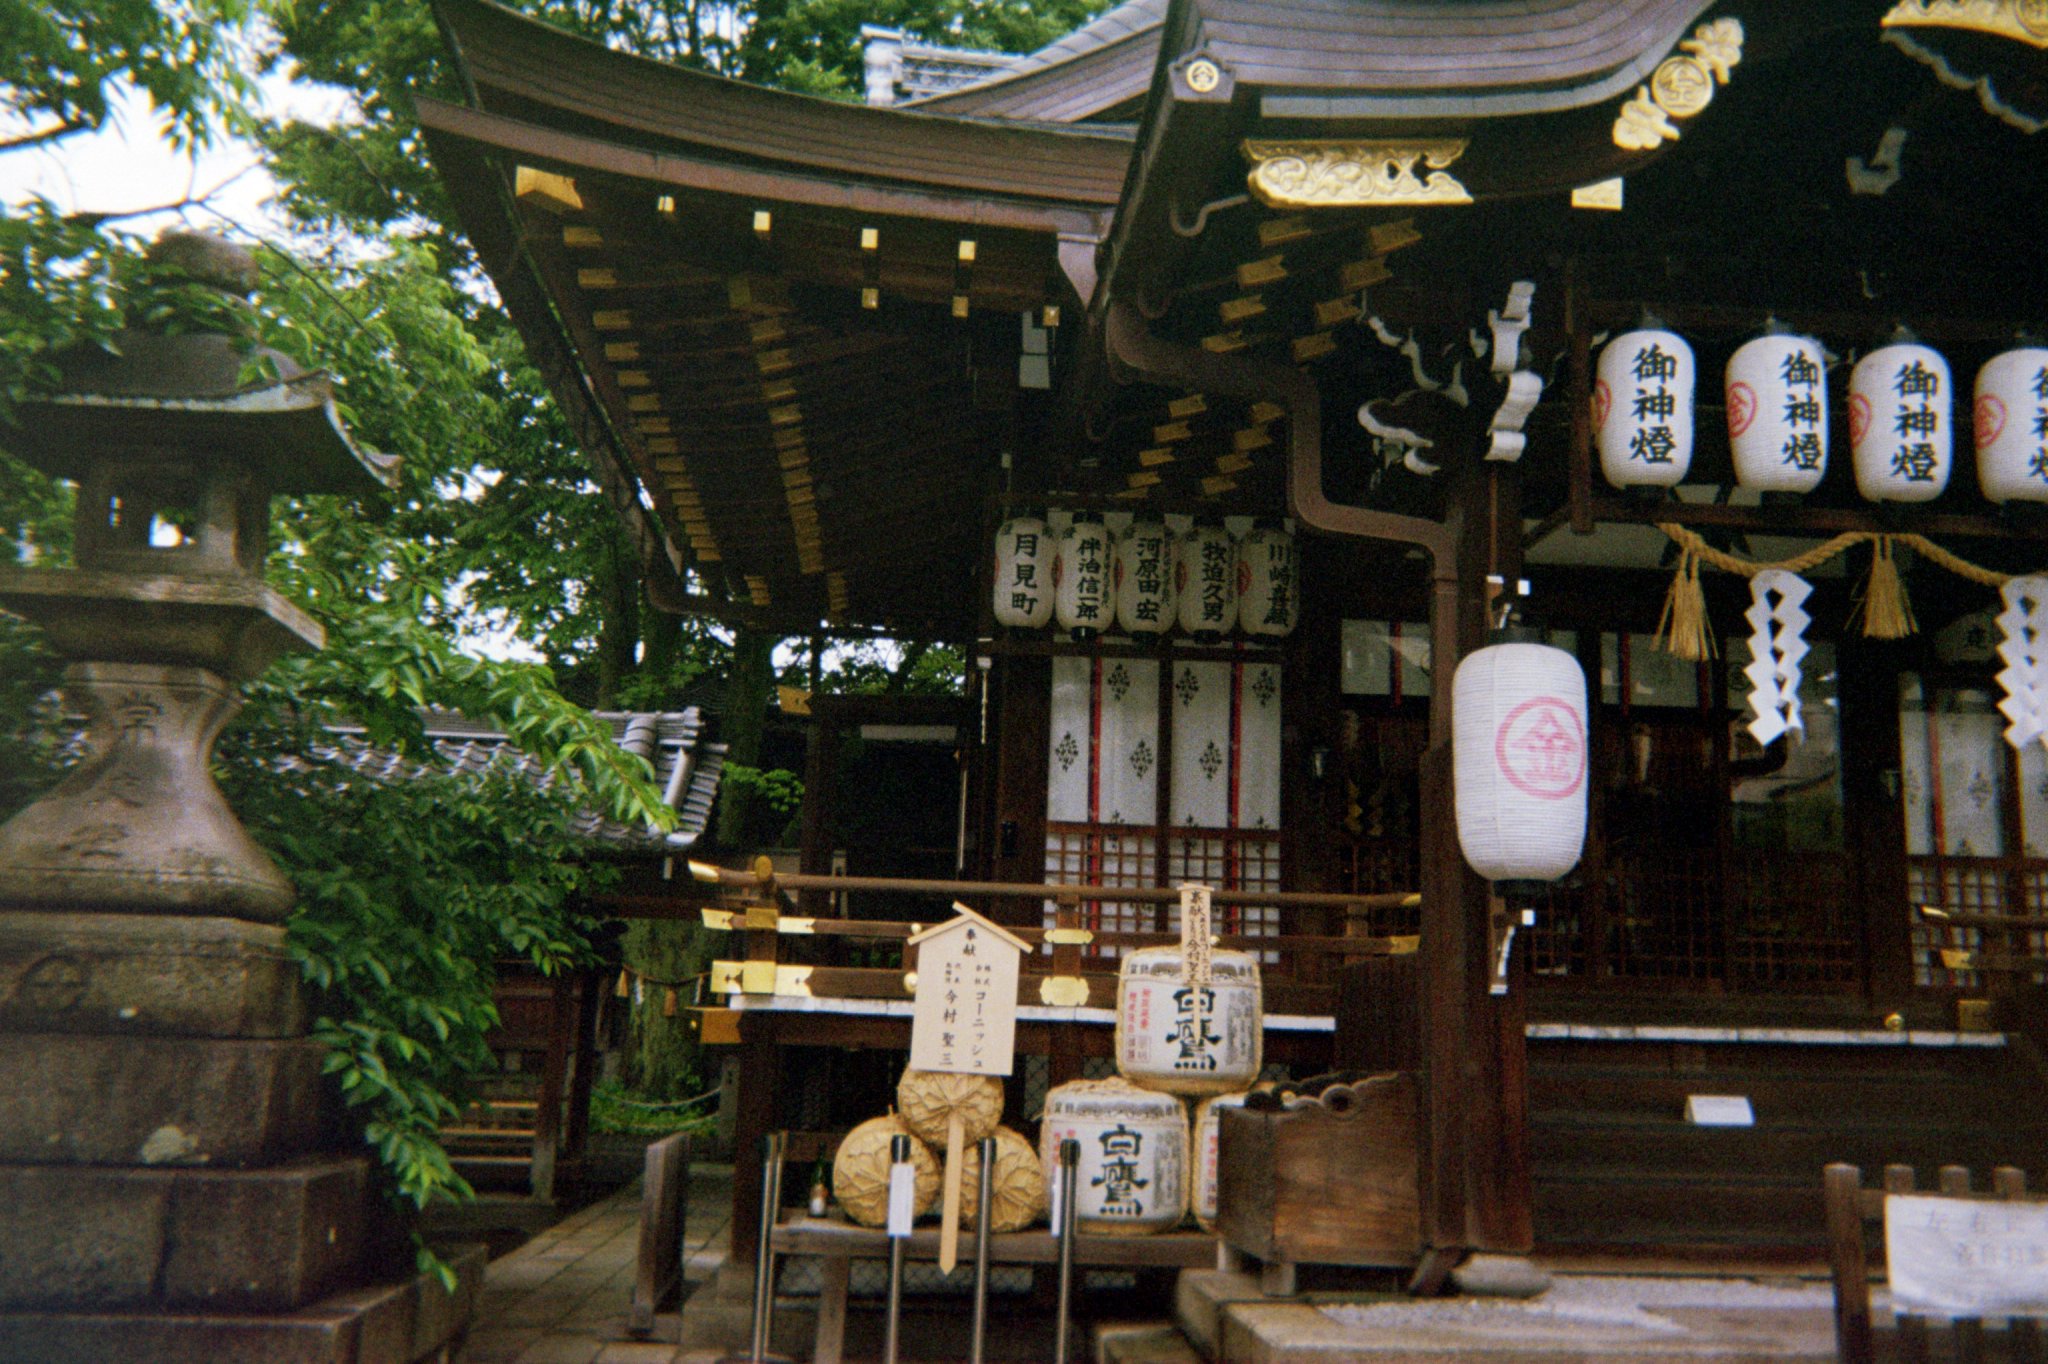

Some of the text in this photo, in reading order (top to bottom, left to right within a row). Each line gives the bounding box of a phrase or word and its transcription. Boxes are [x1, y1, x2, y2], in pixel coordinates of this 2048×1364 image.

[1630, 343, 1677, 465] 御神燈
[1780, 349, 1821, 471] 御神燈
[1891, 359, 1938, 482] 御神燈
[1011, 533, 1038, 616] 月見町
[972, 991, 987, 1068] コーニッシュ
[1091, 1123, 1149, 1216] 白鷹
